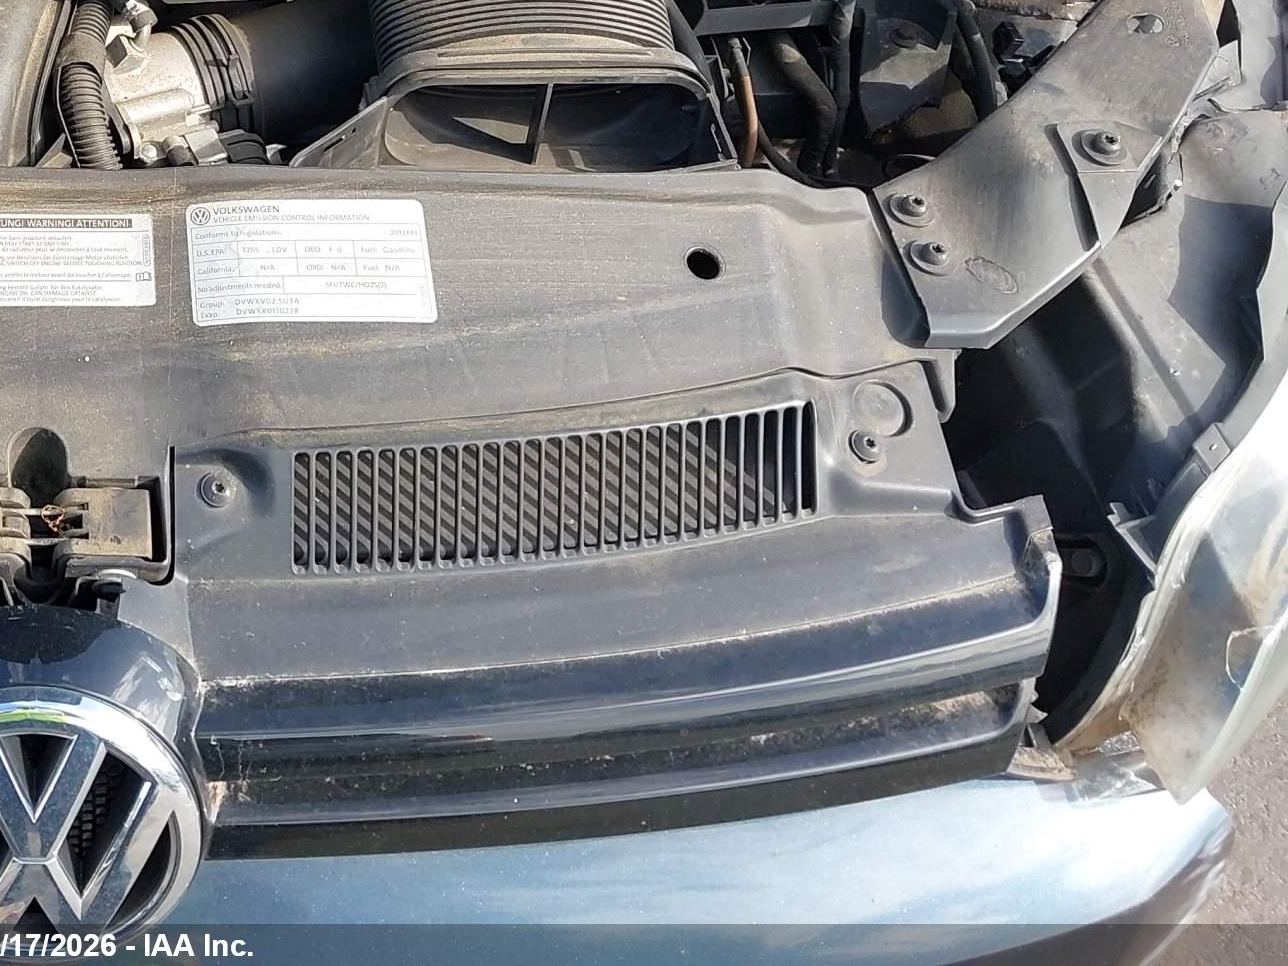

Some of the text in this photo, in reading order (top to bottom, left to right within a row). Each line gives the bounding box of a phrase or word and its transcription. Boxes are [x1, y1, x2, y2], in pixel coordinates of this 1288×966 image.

[213, 205, 280, 215] VOLKSWAGEN
[27, 218, 74, 227] WARNING!
[76, 218, 129, 227] ATTENTION!
[213, 215, 242, 223] VEHICLE
[195, 232, 228, 240] Conforms
